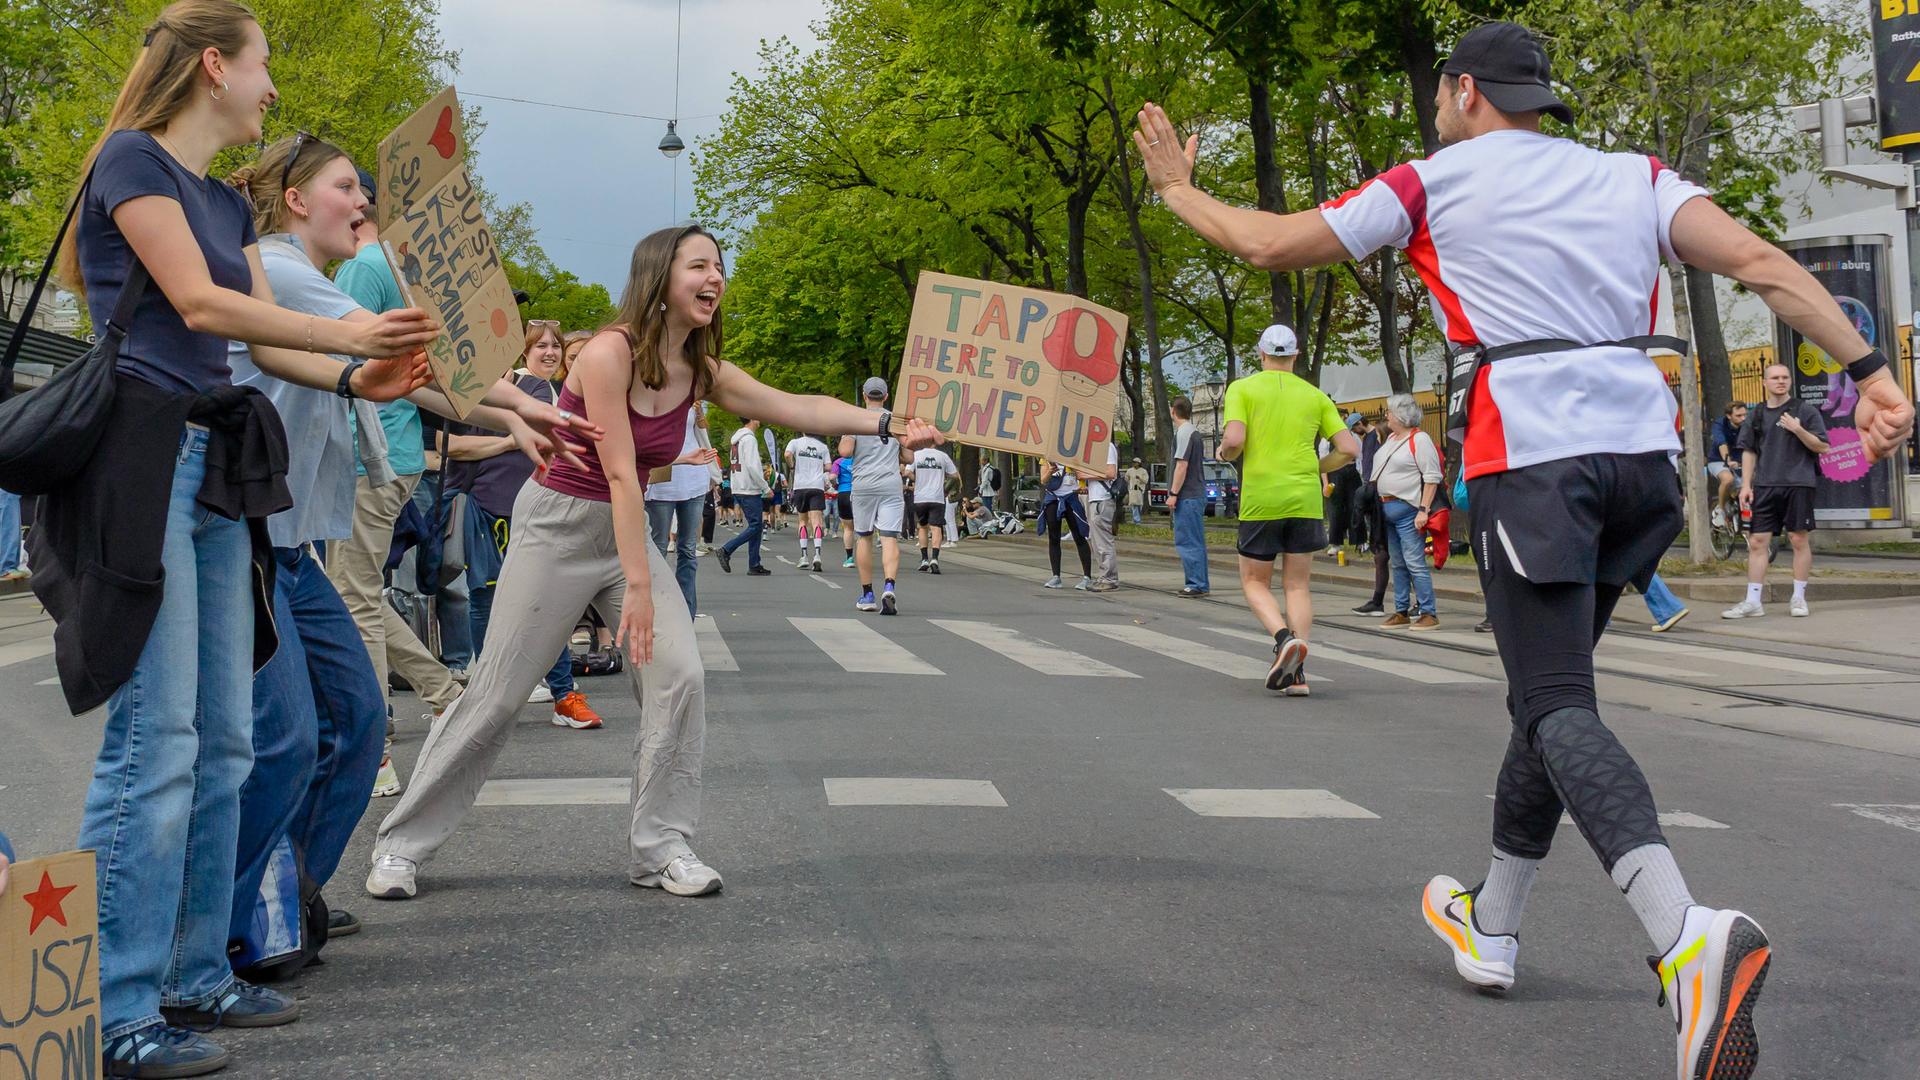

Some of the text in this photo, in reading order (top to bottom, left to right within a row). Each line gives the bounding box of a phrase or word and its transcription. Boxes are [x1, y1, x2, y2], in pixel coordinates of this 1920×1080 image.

[401, 156, 476, 365] SWIMMING
[426, 184, 483, 289] KEEP
[452, 172, 498, 271] JUST
[909, 335, 1040, 387] HERE TO
[932, 284, 1049, 344] TAP
[905, 374, 1108, 465] POWER UP
